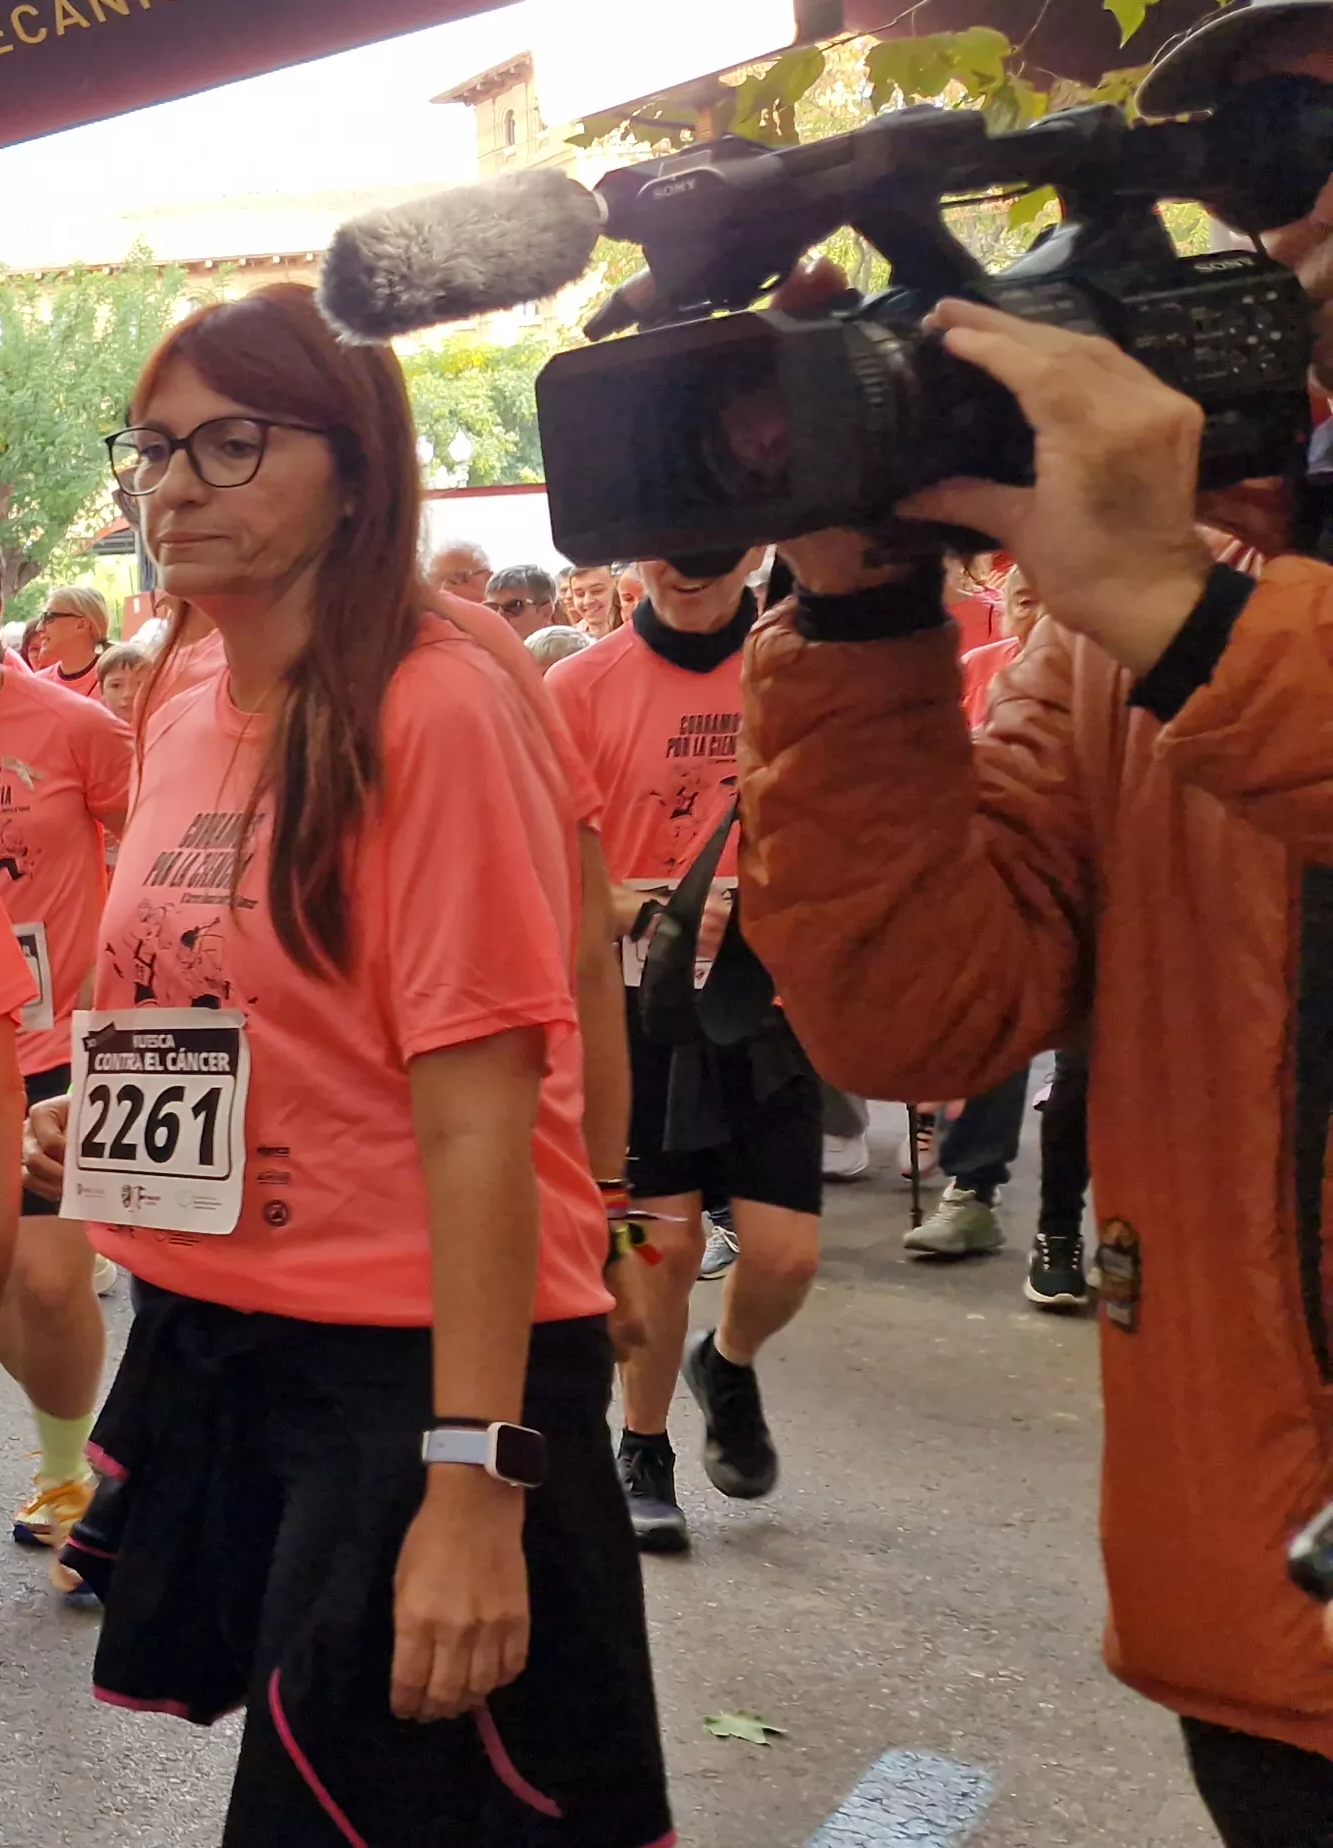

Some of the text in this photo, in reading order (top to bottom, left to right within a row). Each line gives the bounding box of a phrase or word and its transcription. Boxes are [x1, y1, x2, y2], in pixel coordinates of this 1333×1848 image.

[653, 179, 696, 200] SONY
[1193, 256, 1254, 273] SONY
[142, 851, 183, 887] POR
[133, 1034, 175, 1049] HUESCA
[94, 1047, 231, 1072] CONTRA EL CÁNCER
[80, 1083, 224, 1167] 2261
